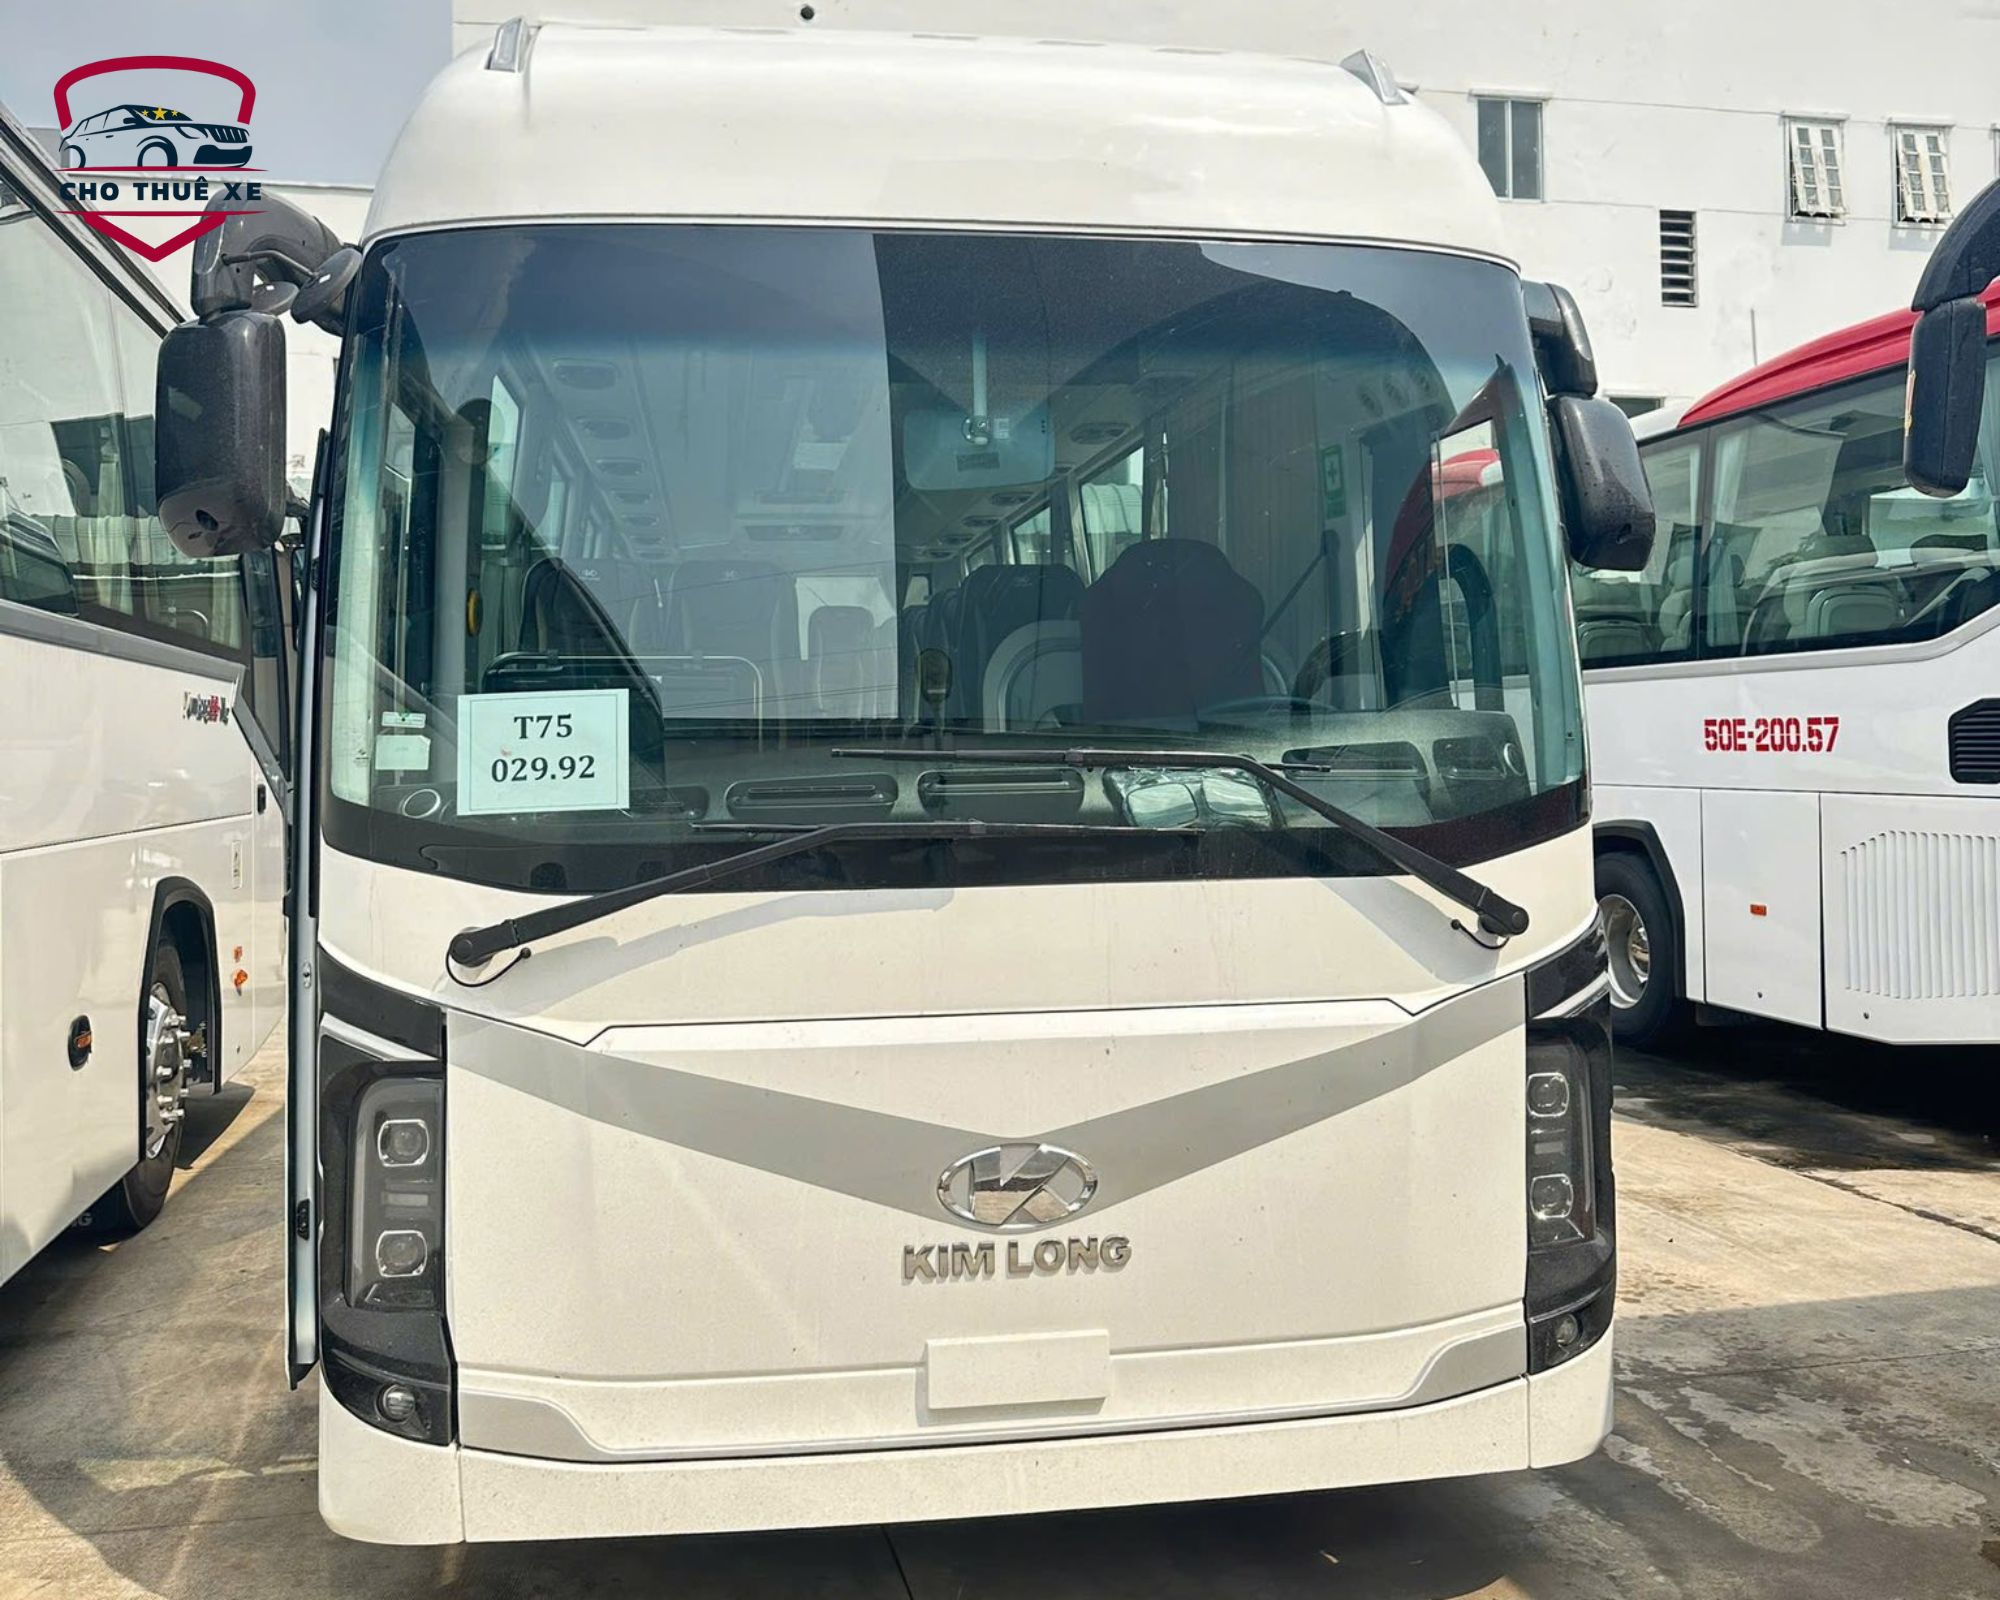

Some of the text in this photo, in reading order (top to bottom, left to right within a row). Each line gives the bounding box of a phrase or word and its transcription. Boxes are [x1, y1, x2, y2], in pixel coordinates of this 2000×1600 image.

[513, 713, 573, 740] T75
[1704, 716, 1840, 753] 50E-200.57
[491, 754, 596, 783] 029.92
[903, 1235, 1133, 1281] KIM LONG
